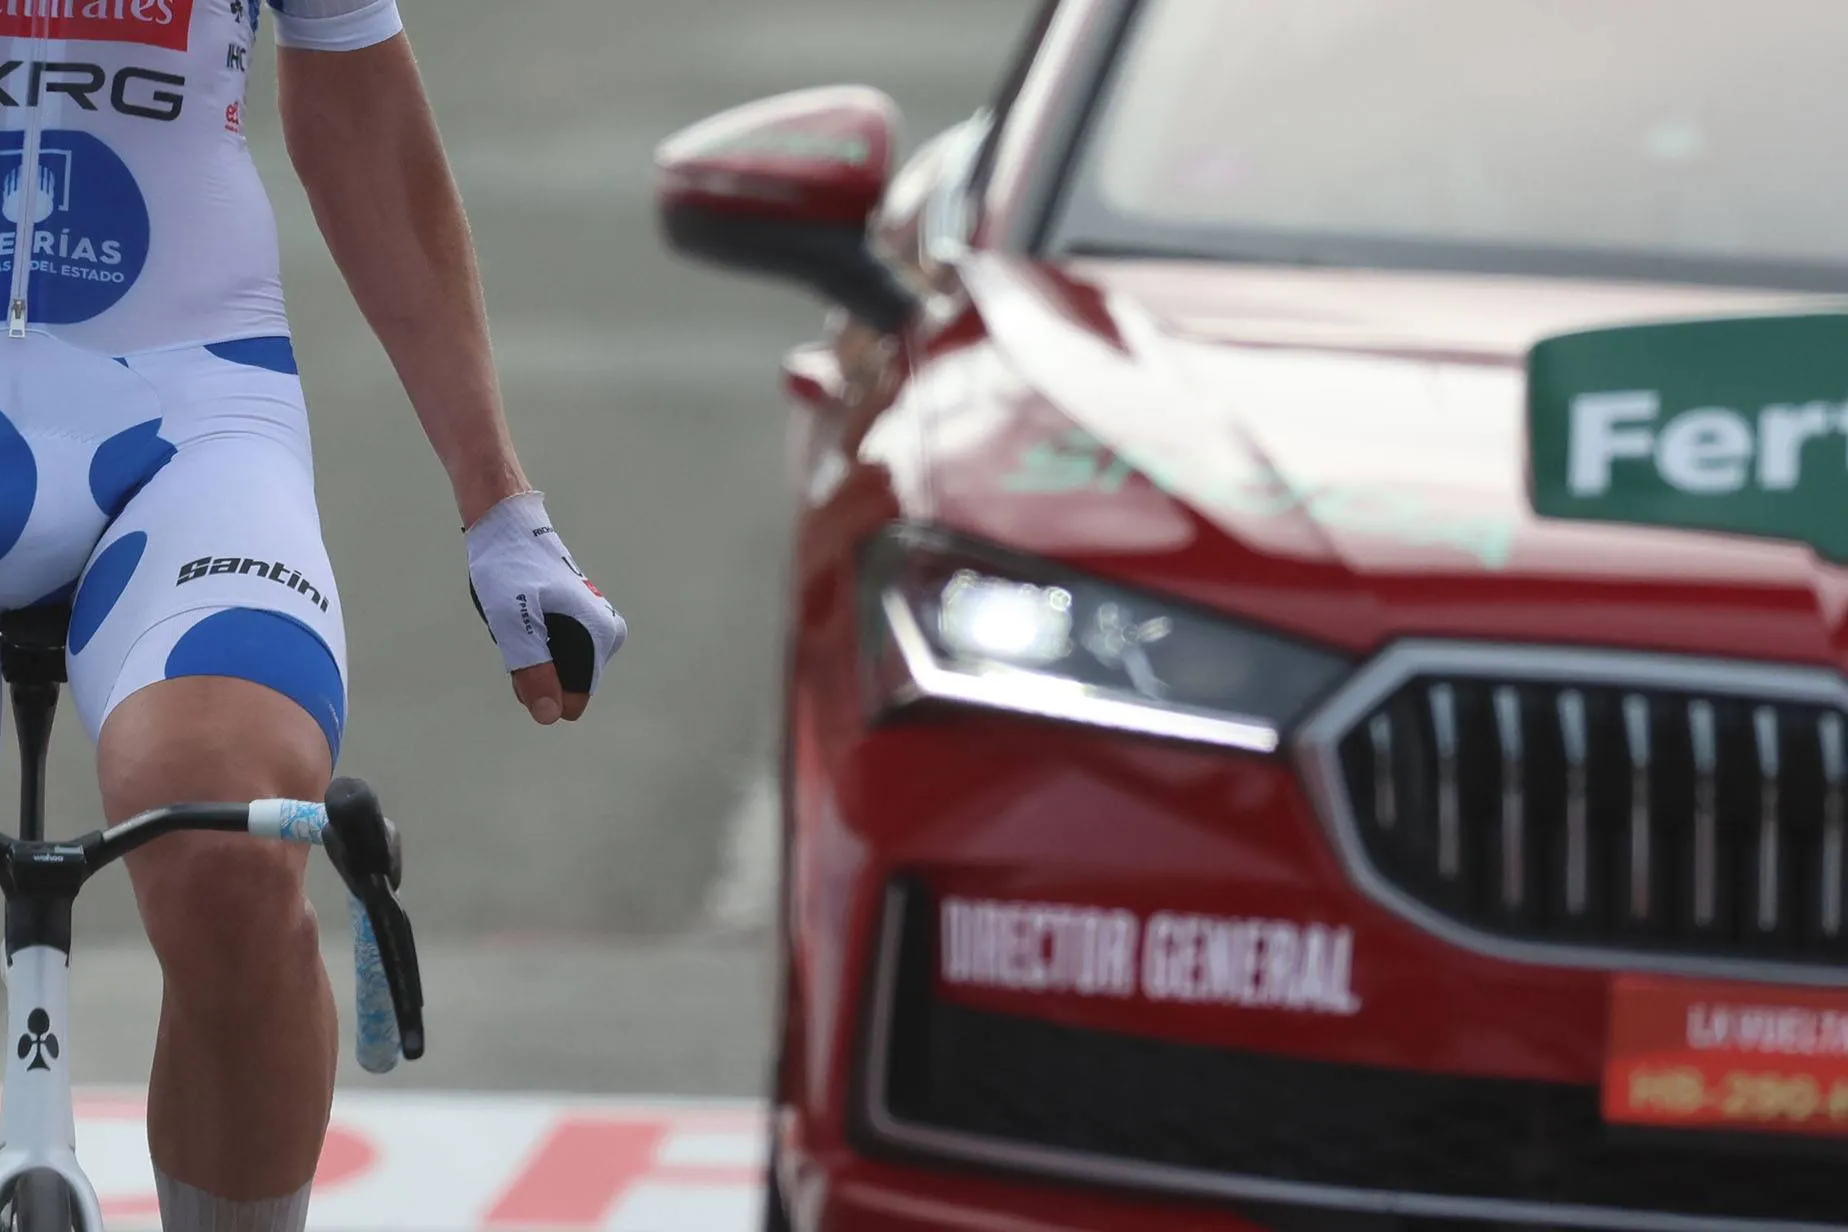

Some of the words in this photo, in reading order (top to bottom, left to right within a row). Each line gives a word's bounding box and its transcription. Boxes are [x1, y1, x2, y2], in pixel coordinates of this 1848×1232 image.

[61, 265, 125, 284] ESTADO
[1566, 387, 1848, 499] Fer
[175, 555, 330, 614] Santini
[939, 896, 1139, 998] DIRECTOR
[1141, 909, 1362, 1017] GENERAL
